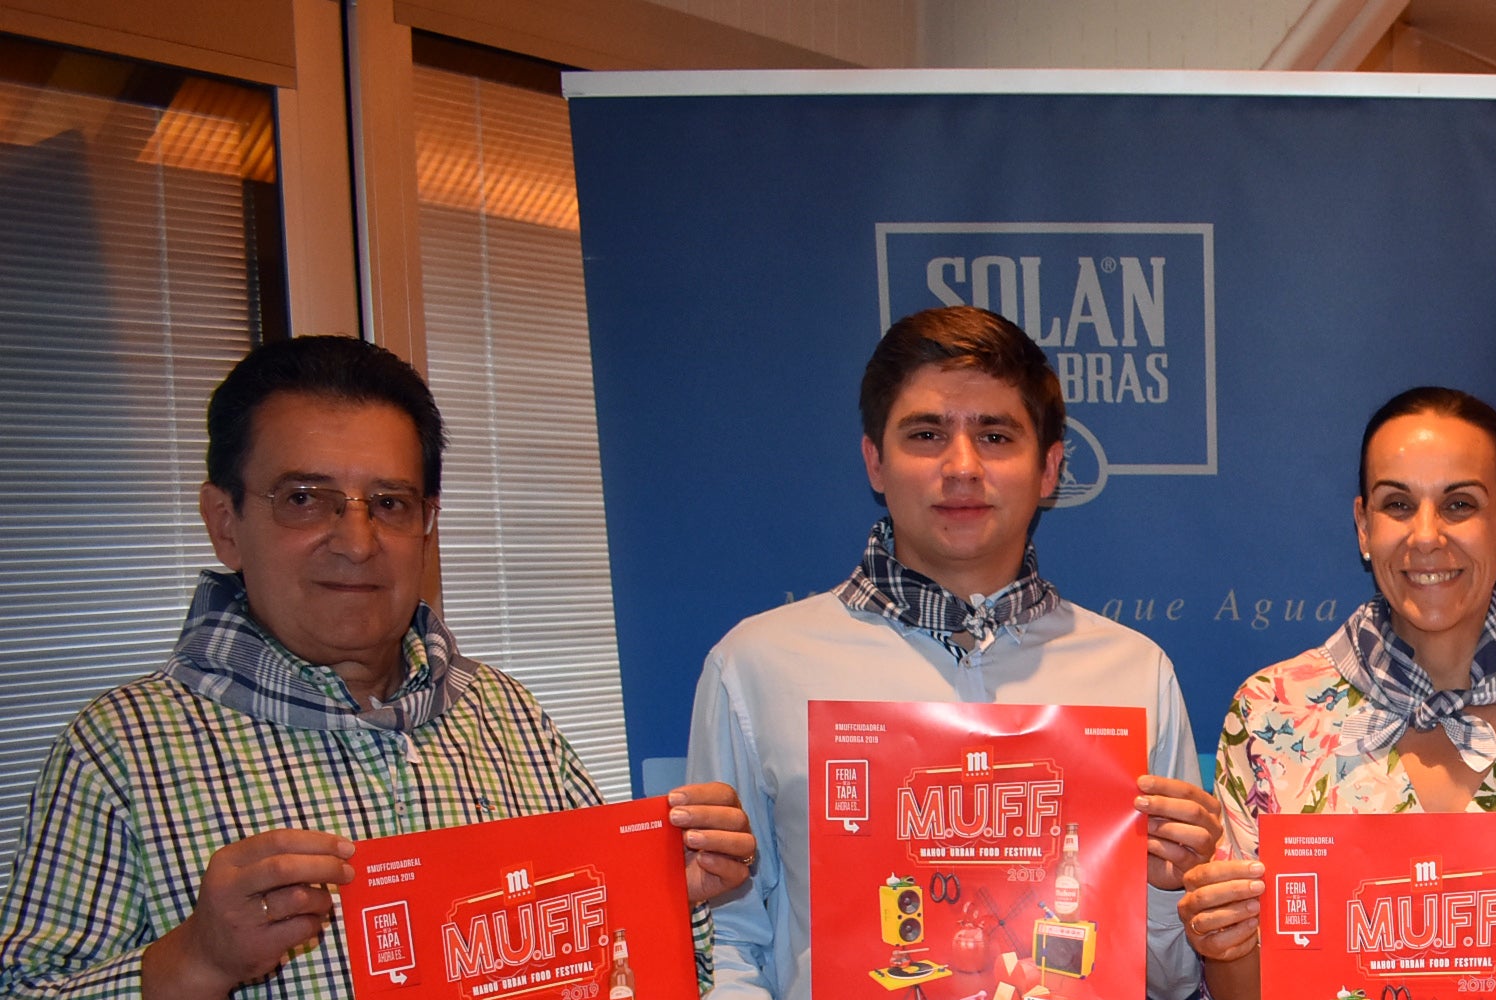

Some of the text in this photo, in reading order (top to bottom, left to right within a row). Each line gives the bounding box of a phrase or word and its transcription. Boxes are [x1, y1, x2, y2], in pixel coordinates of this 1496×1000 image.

[927, 256, 1165, 346] SOLAN
[1057, 353, 1168, 403] BRAS
[1214, 588, 1338, 629] Agua
[836, 769, 856, 780] FERIA
[837, 783, 857, 798] TAPA
[897, 780, 1063, 840] M.U.F.F.
[920, 846, 1042, 856] MAHOU URBAN FOOD FESTIVAL
[1008, 866, 1047, 883] 2019
[1286, 882, 1306, 896] FERIA
[1287, 898, 1306, 912] TAPA
[374, 913, 397, 931] FERIA
[377, 932, 400, 949] TAPA
[442, 886, 609, 982] M.U.F.F.
[1371, 958, 1492, 969] MAHOU URBAN FOOD FESTIVAL
[473, 961, 593, 996] MAHOU URBAN FOOD FESTIVAL
[1458, 976, 1496, 992] 2019
